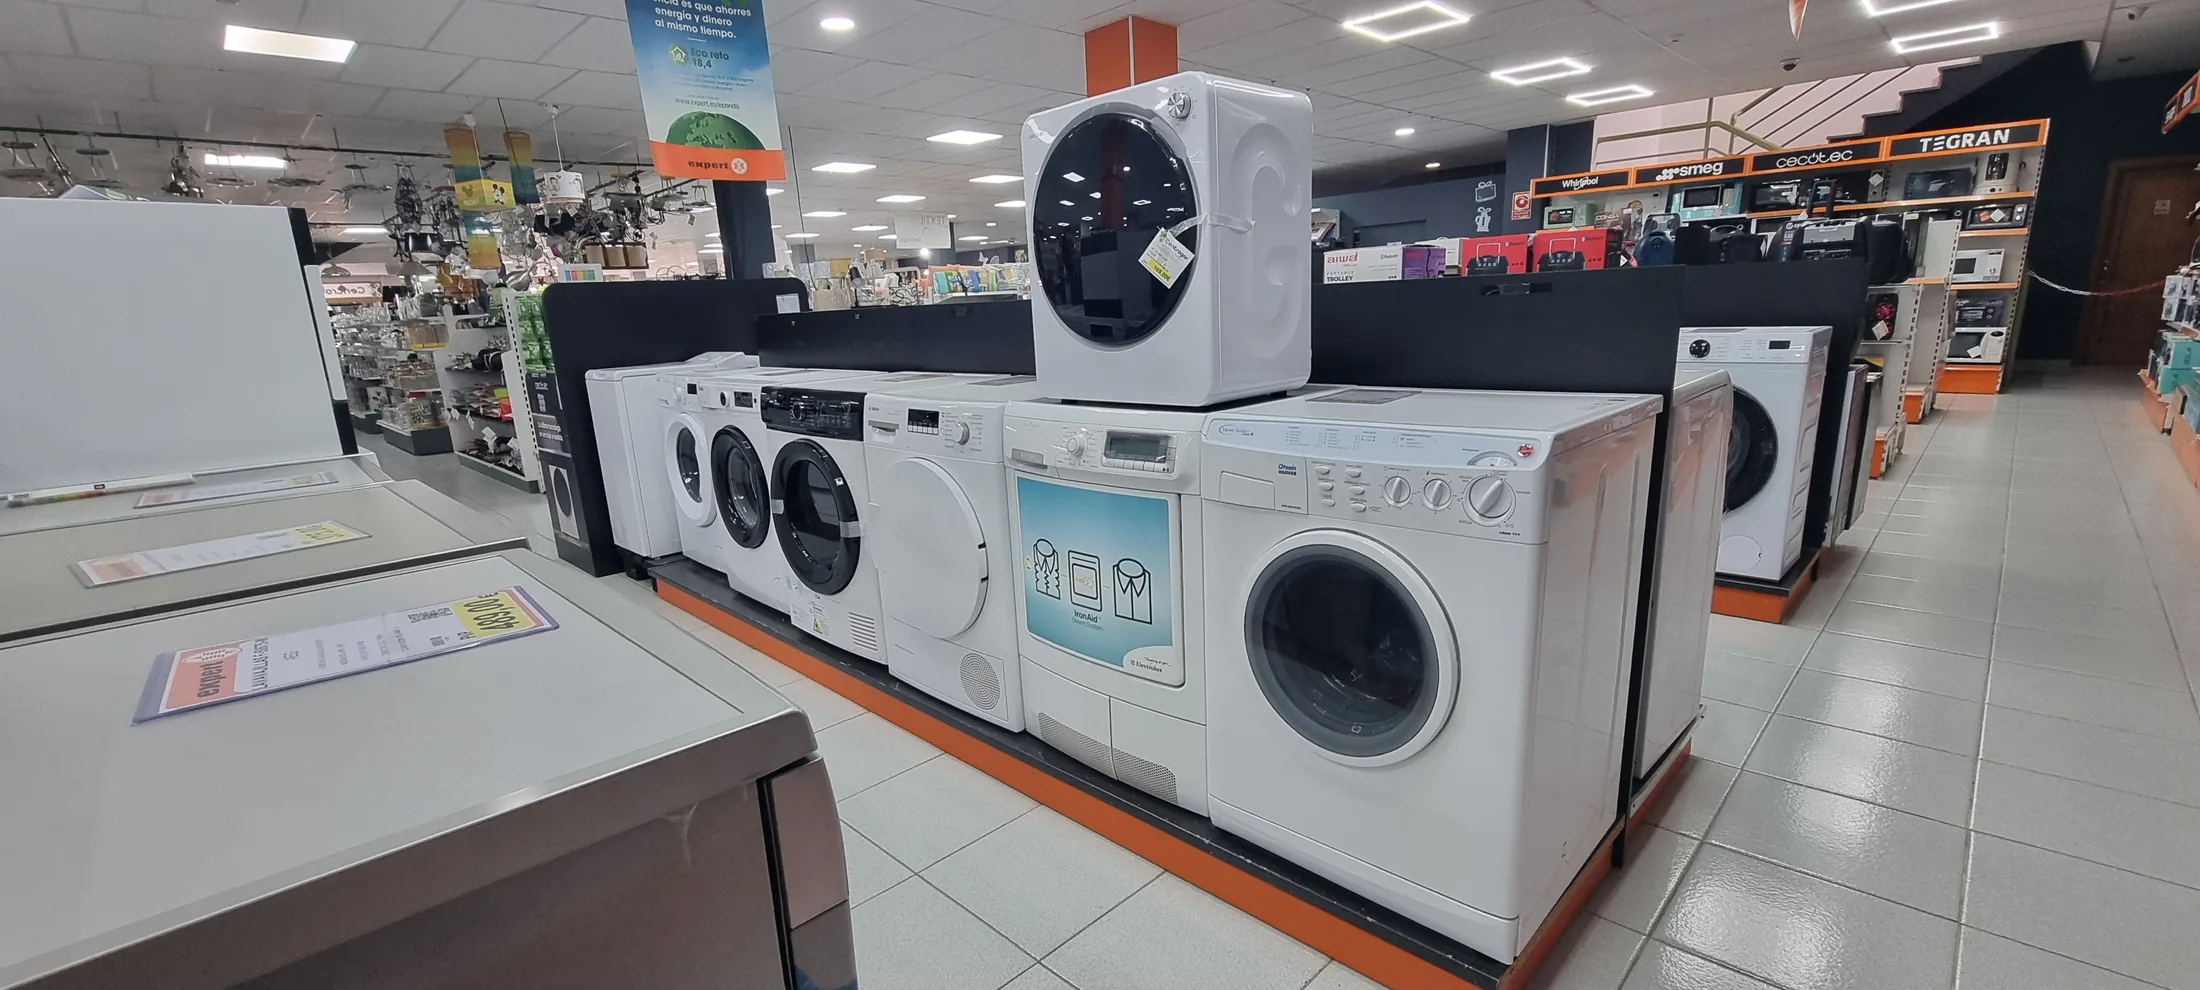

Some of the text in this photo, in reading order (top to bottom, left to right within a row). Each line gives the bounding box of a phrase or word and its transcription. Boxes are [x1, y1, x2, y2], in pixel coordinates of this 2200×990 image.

[655, 7, 733, 26] energía y dinero
[681, 0, 692, 8] es
[695, 3, 713, 12] que
[715, 5, 752, 17] ahorres
[655, 19, 737, 39] al mismo tiempo.
[691, 48, 730, 61] Eco reto
[692, 57, 713, 69] 18,4
[675, 98, 740, 110] www.expert.es/ecoreto
[1919, 129, 2011, 153] TEGRAN
[688, 160, 729, 170] expert
[1776, 150, 1854, 168] cecotec
[1679, 162, 1724, 177] smeg
[1562, 176, 1599, 190] Whirlpool
[1165, 239, 1188, 260] Centrogar
[1327, 251, 1358, 263] aiwa
[463, 598, 520, 631] 489,00
[1136, 661, 1163, 673] Electrolux
[197, 660, 227, 698] expert
